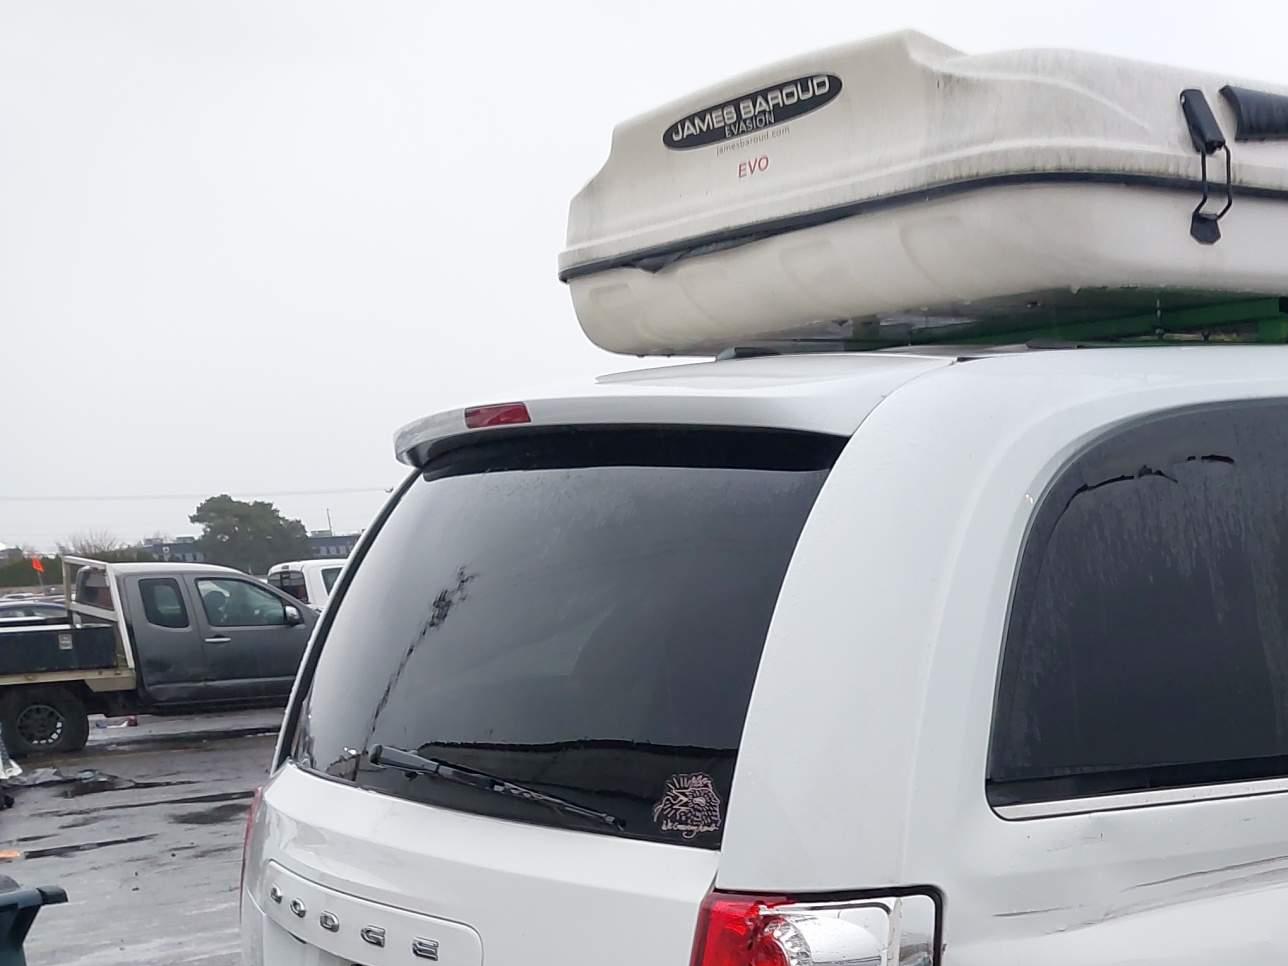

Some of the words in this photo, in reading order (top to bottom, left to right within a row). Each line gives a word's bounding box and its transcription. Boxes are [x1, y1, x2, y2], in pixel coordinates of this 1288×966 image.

[672, 105, 737, 142] JAMES
[740, 75, 830, 119] BAROUD
[725, 111, 776, 138] EVASION
[738, 156, 769, 178] EVO
[270, 884, 439, 962] DODGE
